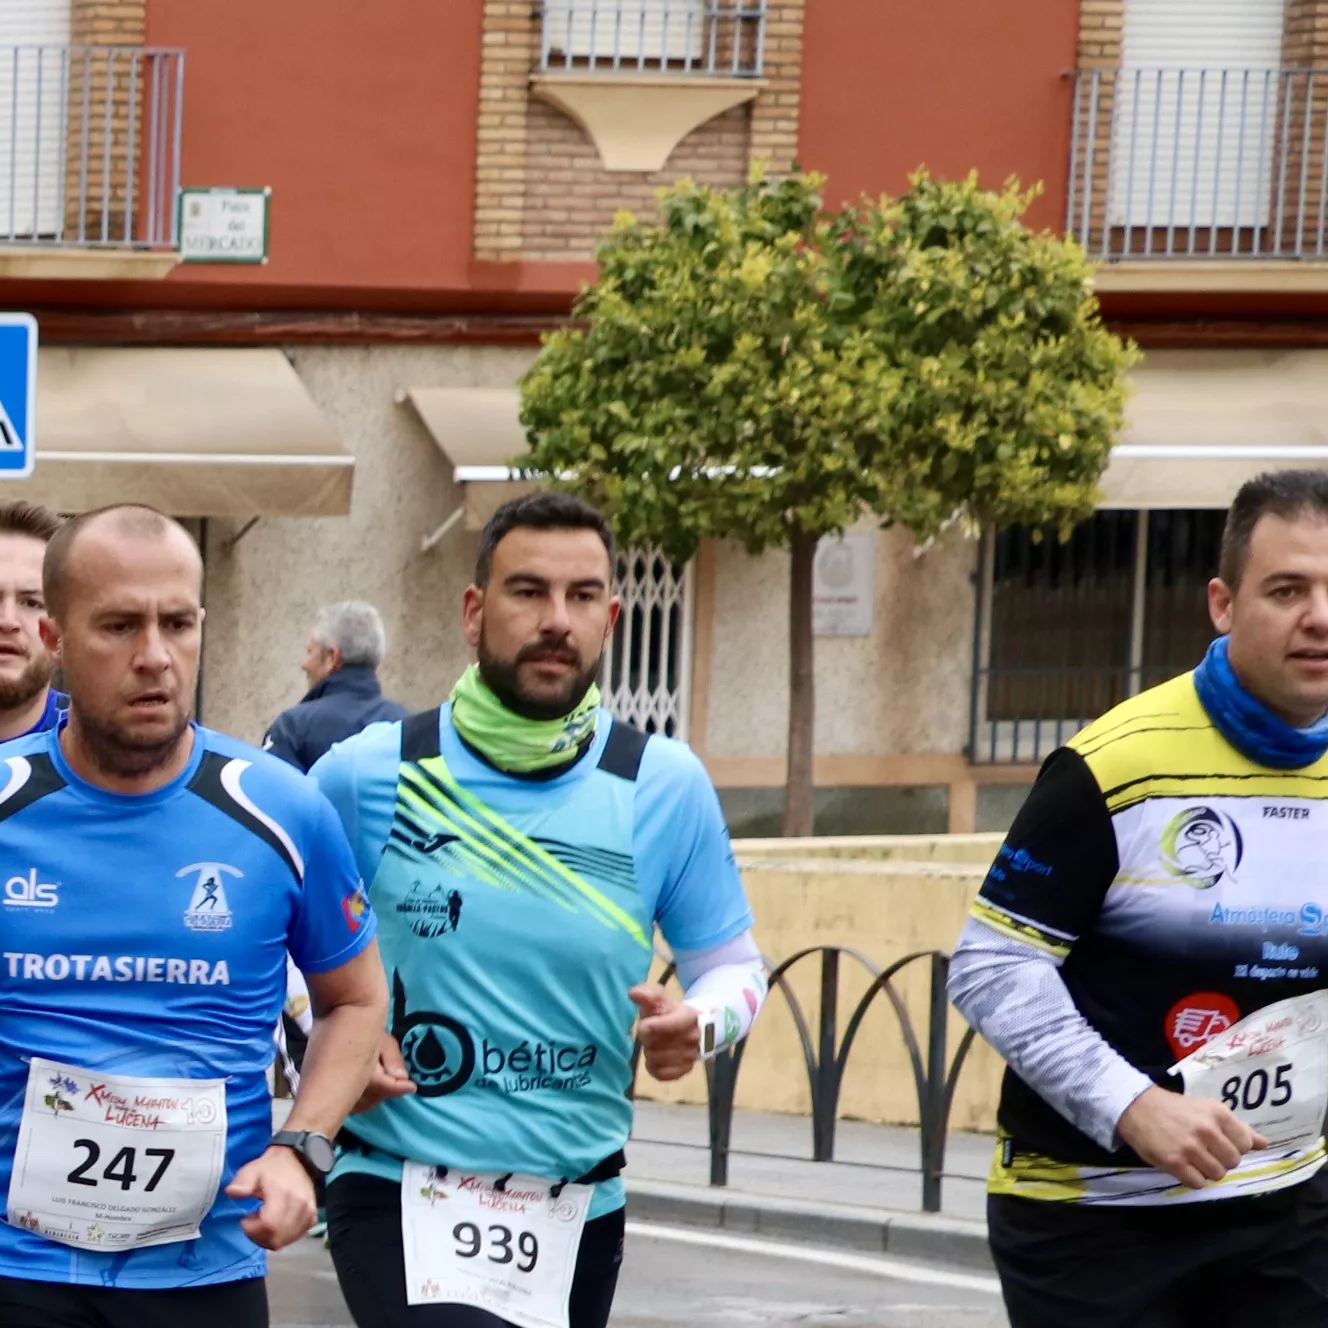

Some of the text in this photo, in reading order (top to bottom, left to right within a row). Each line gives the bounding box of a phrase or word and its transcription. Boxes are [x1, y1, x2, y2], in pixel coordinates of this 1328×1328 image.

[1262, 807, 1311, 820] FASTER
[2, 952, 231, 985] TROTASIERRA
[482, 1038, 598, 1075] bética
[1221, 1062, 1294, 1112] 805
[104, 1105, 167, 1131] LUCENA
[66, 1139, 176, 1193] 247
[67, 1198, 107, 1211] FRANCISCO
[108, 1204, 142, 1214] DELGADO
[451, 1222, 539, 1273] 939
